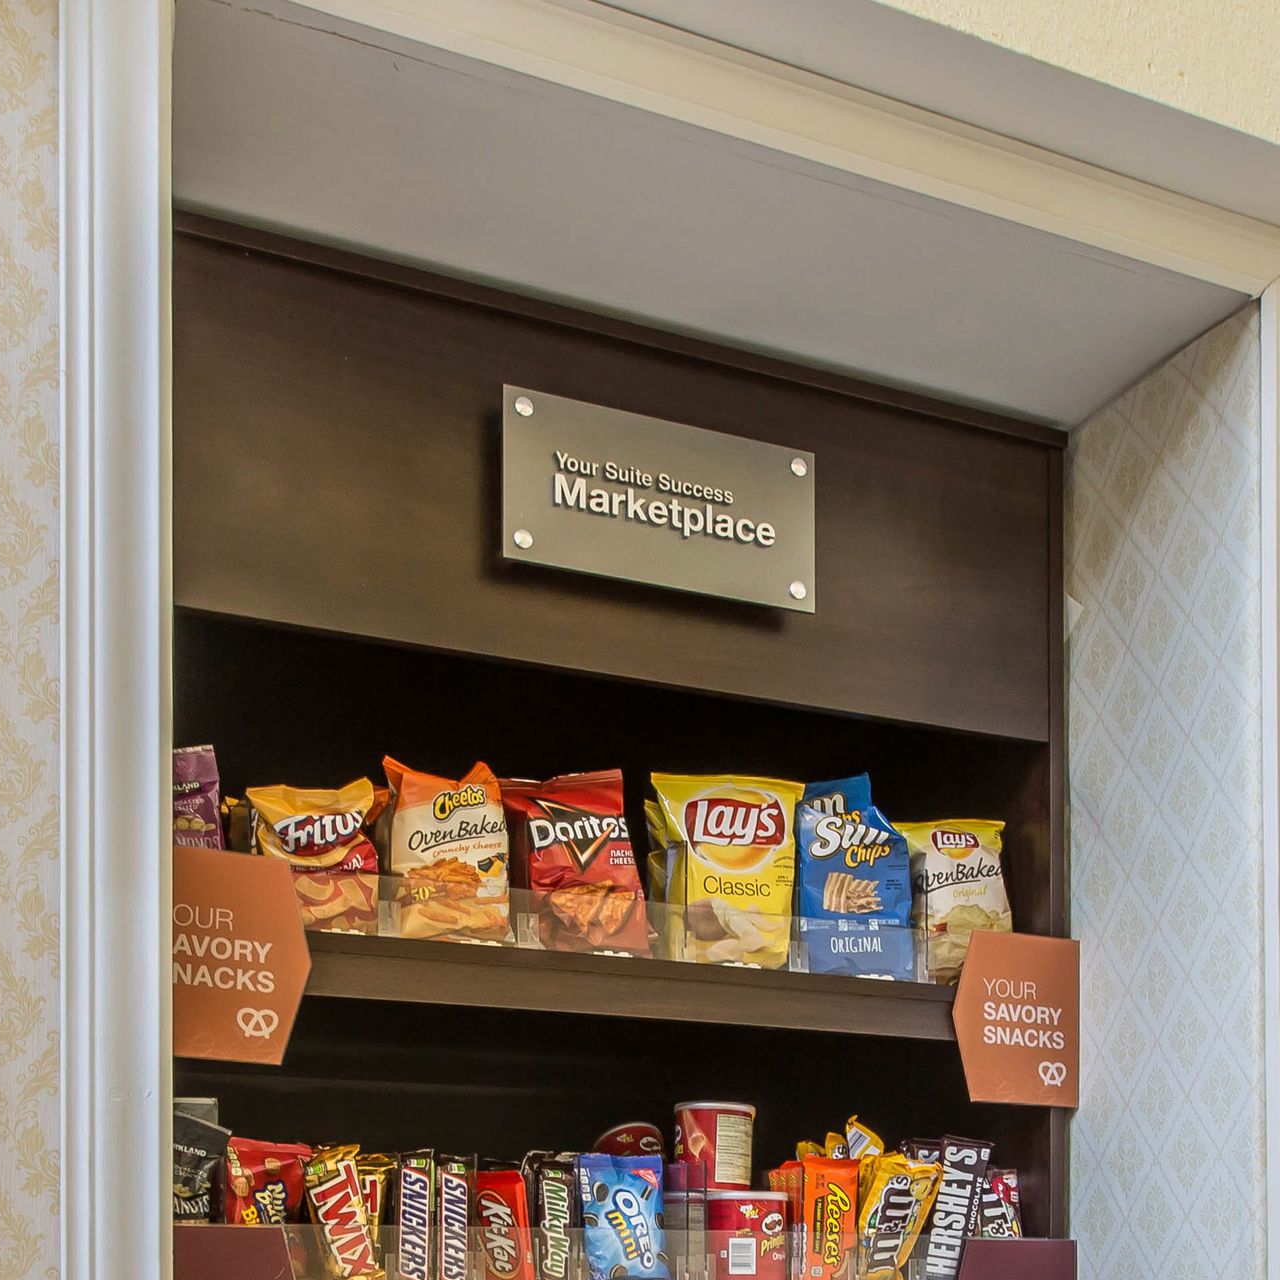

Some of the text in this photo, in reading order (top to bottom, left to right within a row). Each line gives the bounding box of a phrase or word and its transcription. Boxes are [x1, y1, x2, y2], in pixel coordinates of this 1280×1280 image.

[554, 450, 734, 504] Your Suite Success
[553, 473, 776, 547] Marketplace
[433, 786, 485, 820] Cheetos
[273, 811, 363, 853] Fritos
[529, 816, 629, 848] Doritos
[693, 801, 778, 846] Lay's
[936, 831, 975, 848] Lay's
[845, 844, 892, 866] Chips
[704, 875, 771, 896] Classic
[173, 937, 273, 964] AVORY
[830, 937, 883, 953] ORIGINAL
[173, 964, 275, 994] NACKS
[983, 977, 1037, 1000] YOUR
[983, 1001, 1062, 1026] SAVORY
[983, 1026, 1065, 1050] SNACKS
[311, 1161, 376, 1277] TWIX
[925, 1146, 979, 1276] HERSHEY'S
[969, 1177, 983, 1230] CHOCOLATE
[605, 1211, 641, 1260] mini
[615, 1190, 654, 1269] OREO
[824, 1182, 851, 1268] Reese's
